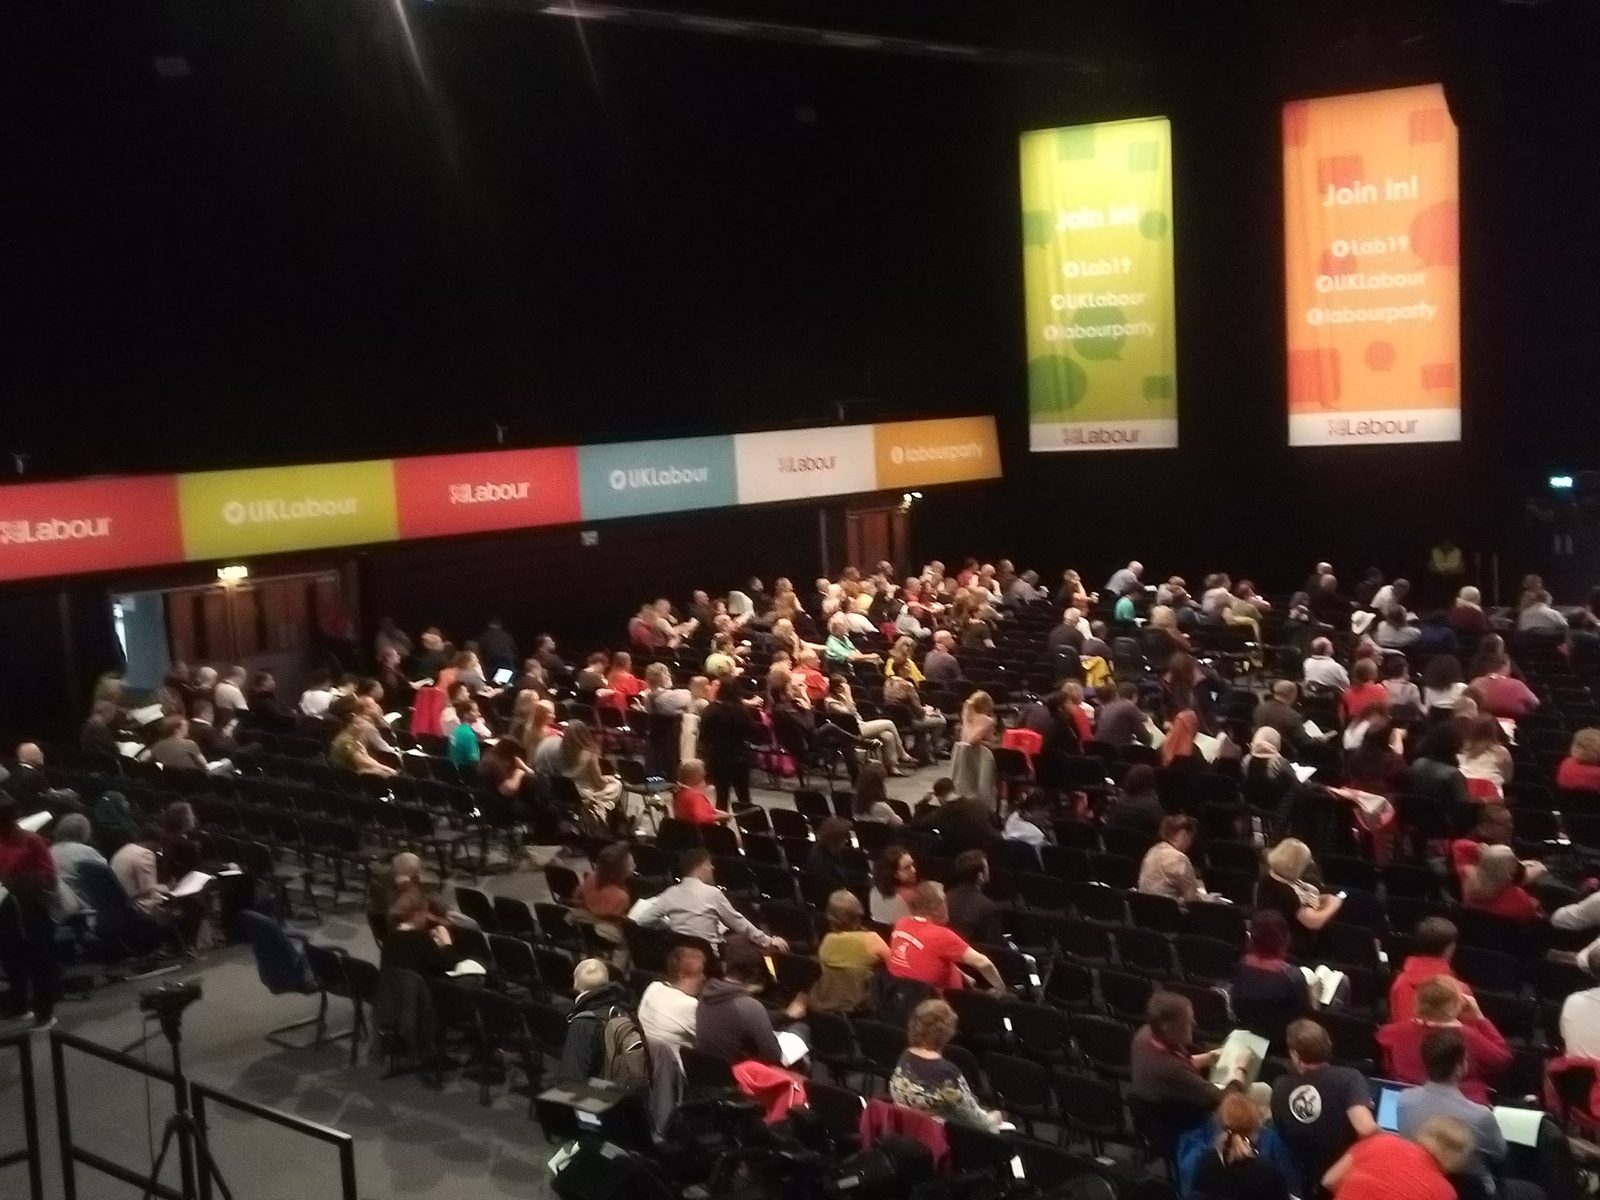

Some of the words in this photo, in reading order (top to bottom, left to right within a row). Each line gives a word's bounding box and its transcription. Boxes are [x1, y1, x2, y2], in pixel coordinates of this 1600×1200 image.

[1322, 180, 1377, 207] Join
[1351, 235, 1410, 256] Lab19
[1079, 428, 1142, 445] Labour
[1346, 417, 1418, 436] Labour
[792, 455, 837, 473] Labour
[627, 466, 709, 488] UKLabour
[467, 481, 531, 503] Labour
[250, 498, 358, 523] UKLabour
[26, 517, 112, 543] Labour
